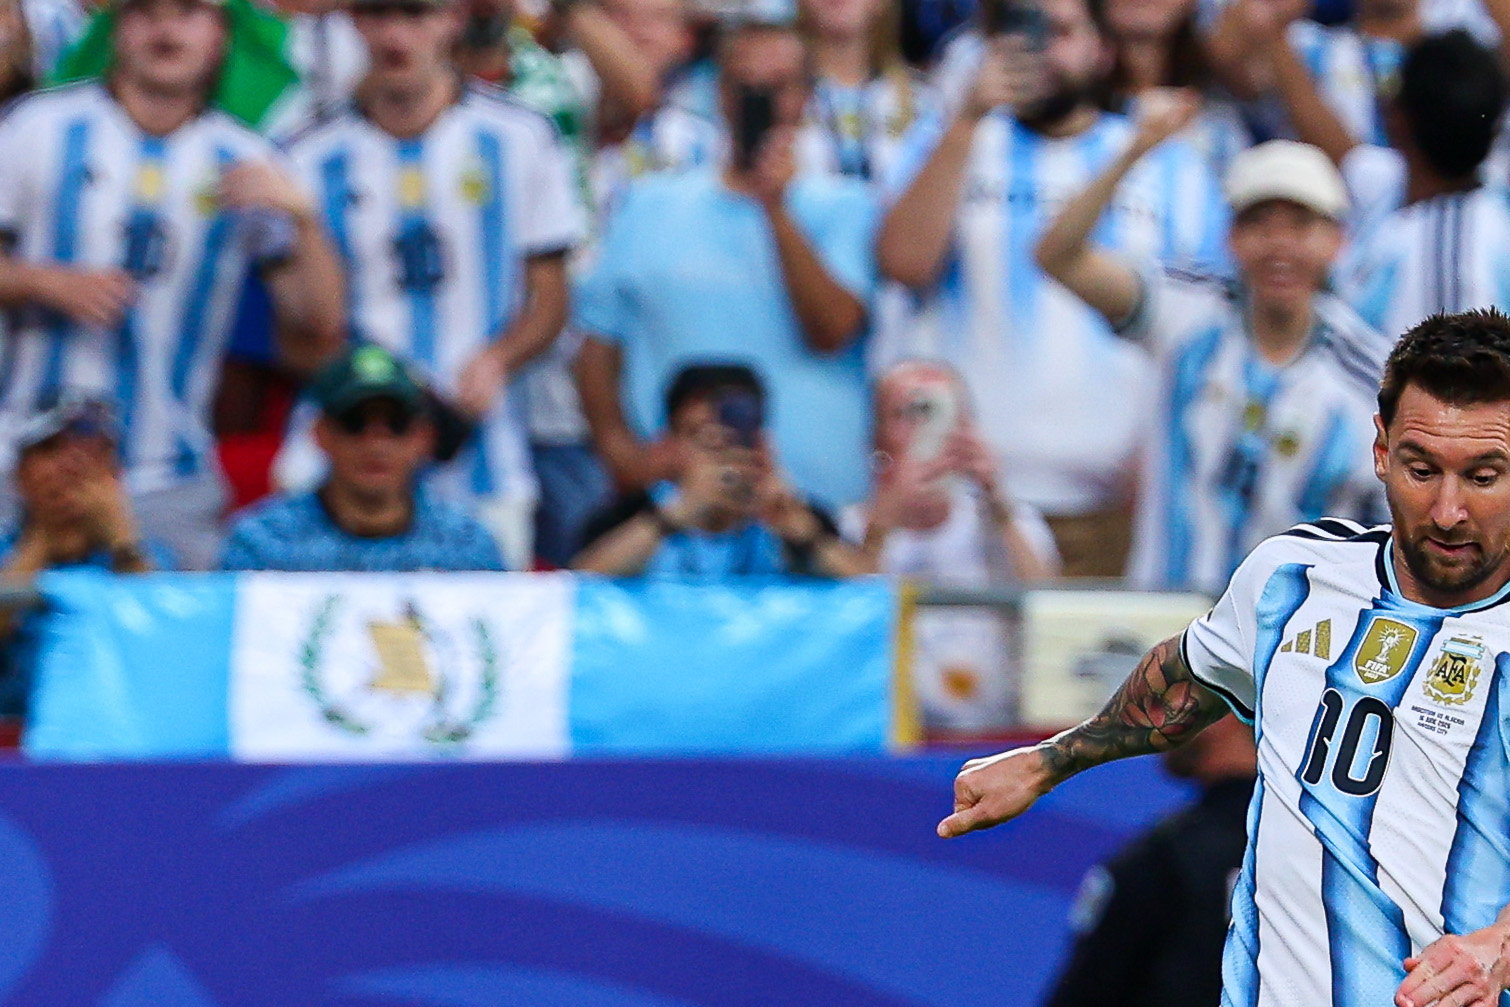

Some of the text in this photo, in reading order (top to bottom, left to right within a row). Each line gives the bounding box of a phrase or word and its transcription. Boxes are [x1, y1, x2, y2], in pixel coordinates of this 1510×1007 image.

[1365, 660, 1388, 674] FIFA
[1434, 653, 1467, 687] AFA
[1301, 688, 1395, 797] 10
